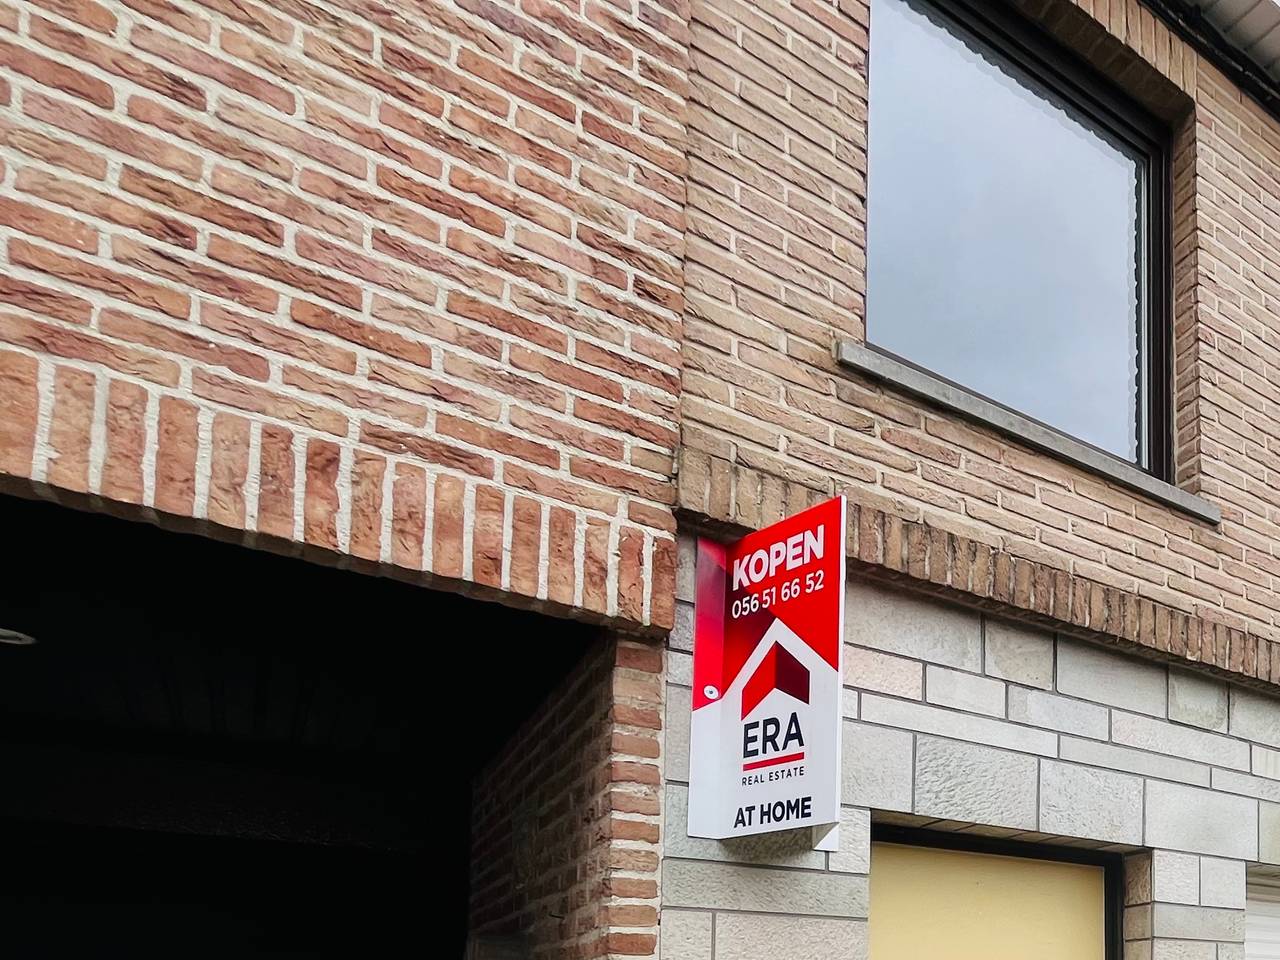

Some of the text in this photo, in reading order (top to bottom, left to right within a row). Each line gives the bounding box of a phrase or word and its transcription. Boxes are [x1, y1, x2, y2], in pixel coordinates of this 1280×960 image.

[732, 524, 825, 591] KOPEN
[732, 569, 825, 619] 056 51 66 52
[743, 711, 805, 759] ERA
[741, 766, 805, 786] REAL ESTATE
[733, 796, 812, 828] AT HOME
